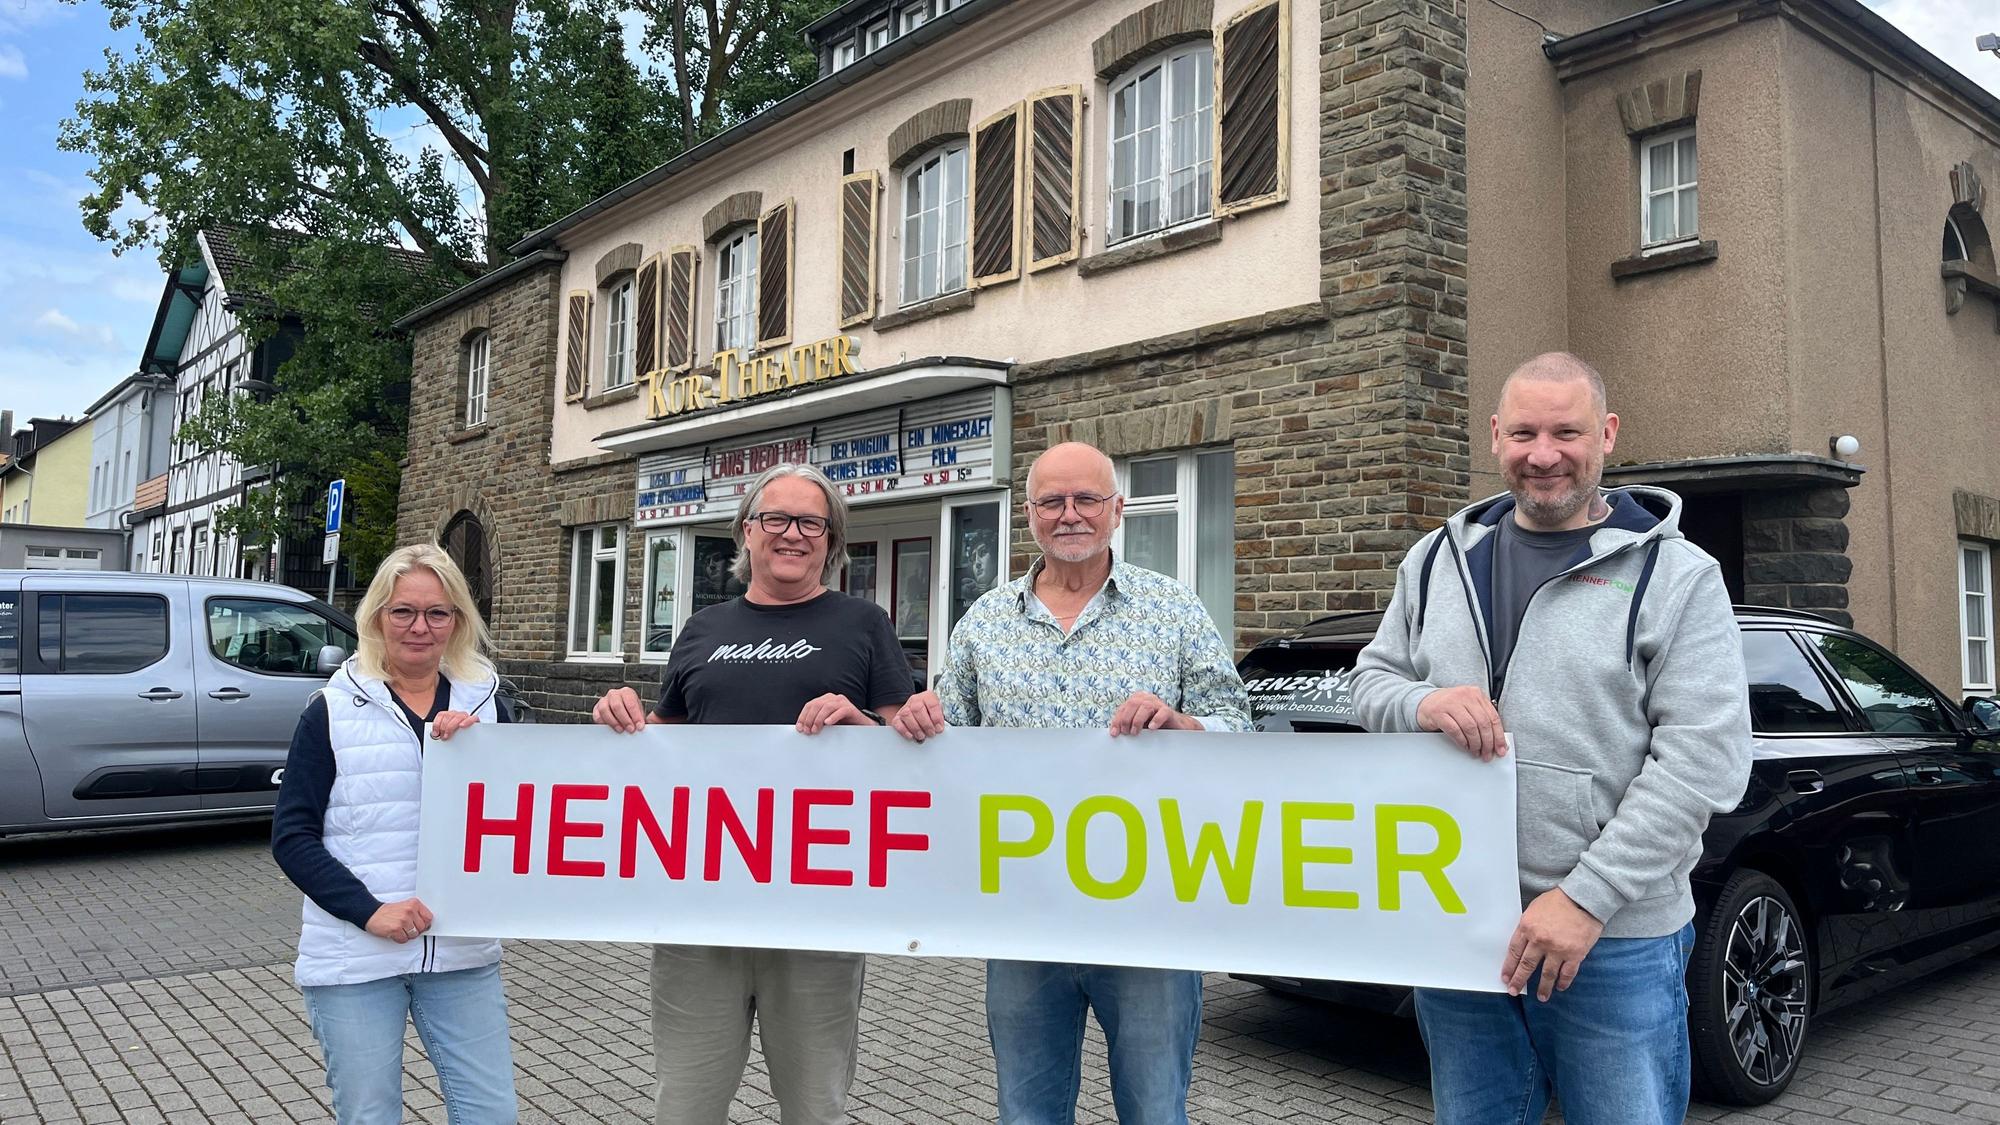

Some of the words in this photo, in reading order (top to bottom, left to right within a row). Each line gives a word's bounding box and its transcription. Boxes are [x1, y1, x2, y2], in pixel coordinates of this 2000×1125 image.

[908, 428, 924, 448] EIN
[932, 416, 992, 445] MINECRAFT
[831, 441, 848, 460] DER
[851, 434, 889, 457] PINGUIN
[932, 447, 957, 466] FILM
[711, 447, 745, 479] LARS
[823, 462, 857, 482] MEINES
[862, 456, 897, 477] LEBENS
[846, 484, 855, 496] SA
[861, 481, 870, 494] SO
[924, 473, 933, 485] SA
[940, 470, 949, 483] SO
[329, 488, 338, 526] P
[707, 638, 822, 663] mahalo
[463, 782, 932, 888] HENNEF
[979, 794, 1468, 915] POWER
